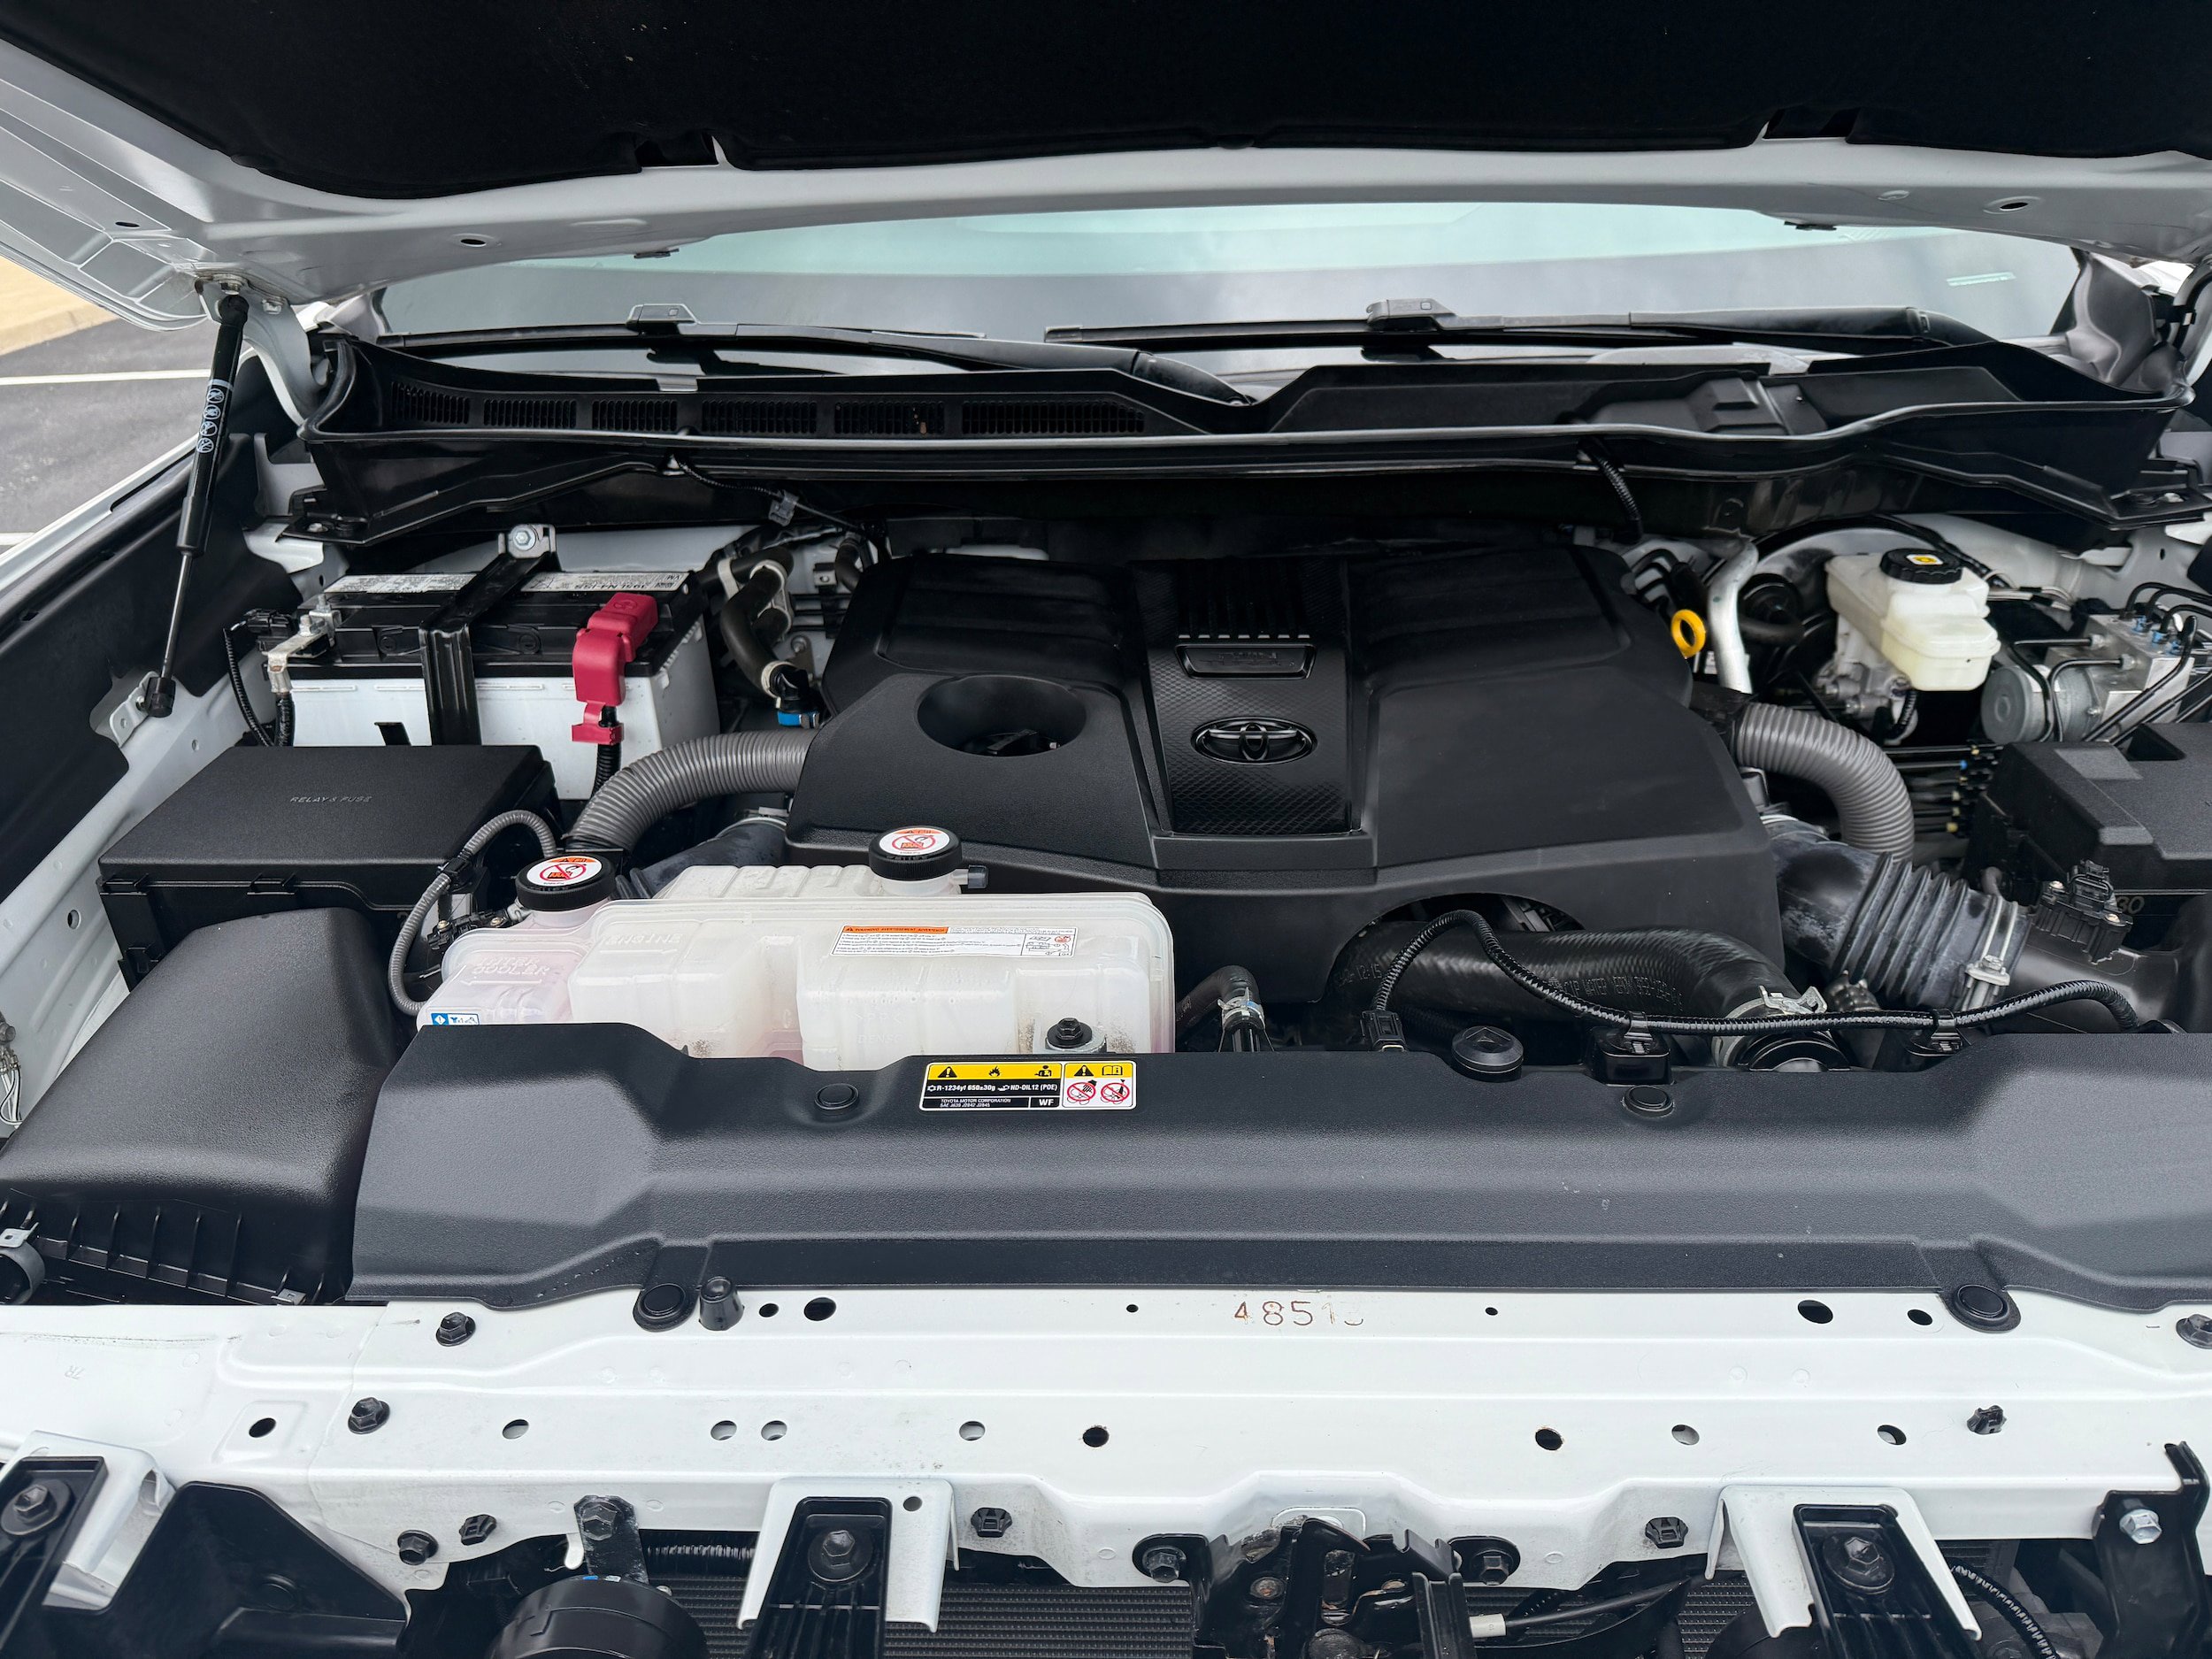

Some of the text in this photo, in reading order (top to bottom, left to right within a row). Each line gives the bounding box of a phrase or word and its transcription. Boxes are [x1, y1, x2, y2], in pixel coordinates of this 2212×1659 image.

[603, 933, 683, 945] ENGINE
[472, 964, 550, 975] COOLER
[936, 1084, 966, 1093] R-1234yf
[1040, 1083, 1058, 1092] (POE)
[1233, 1300, 1364, 1326] 4851
